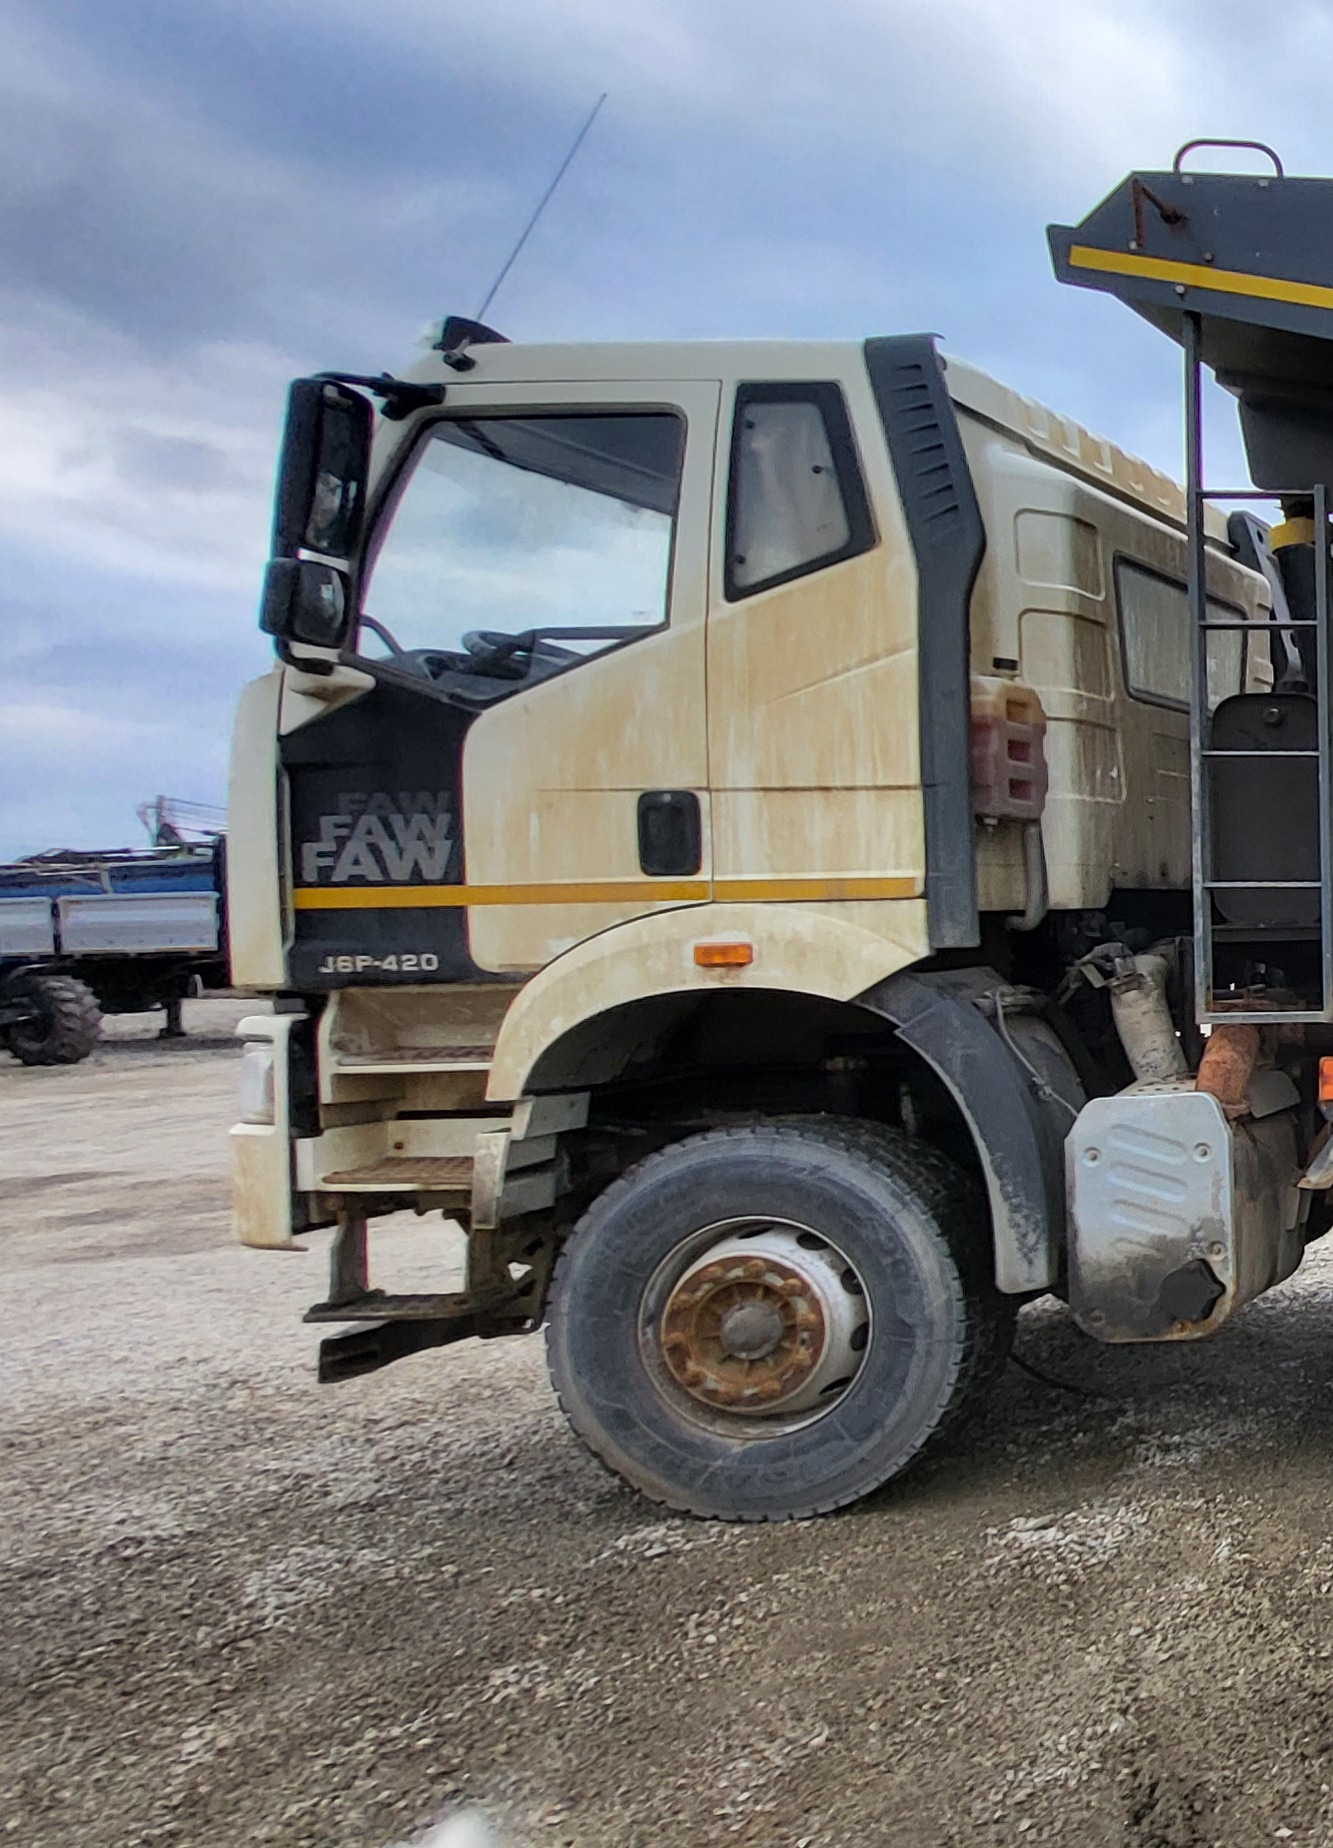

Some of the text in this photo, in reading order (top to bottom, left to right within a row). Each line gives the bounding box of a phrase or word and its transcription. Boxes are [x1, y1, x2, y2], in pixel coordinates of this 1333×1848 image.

[337, 791, 451, 816] FAW
[318, 813, 452, 844] FAW
[301, 839, 452, 882] FAW
[318, 953, 439, 973] J6P-420
